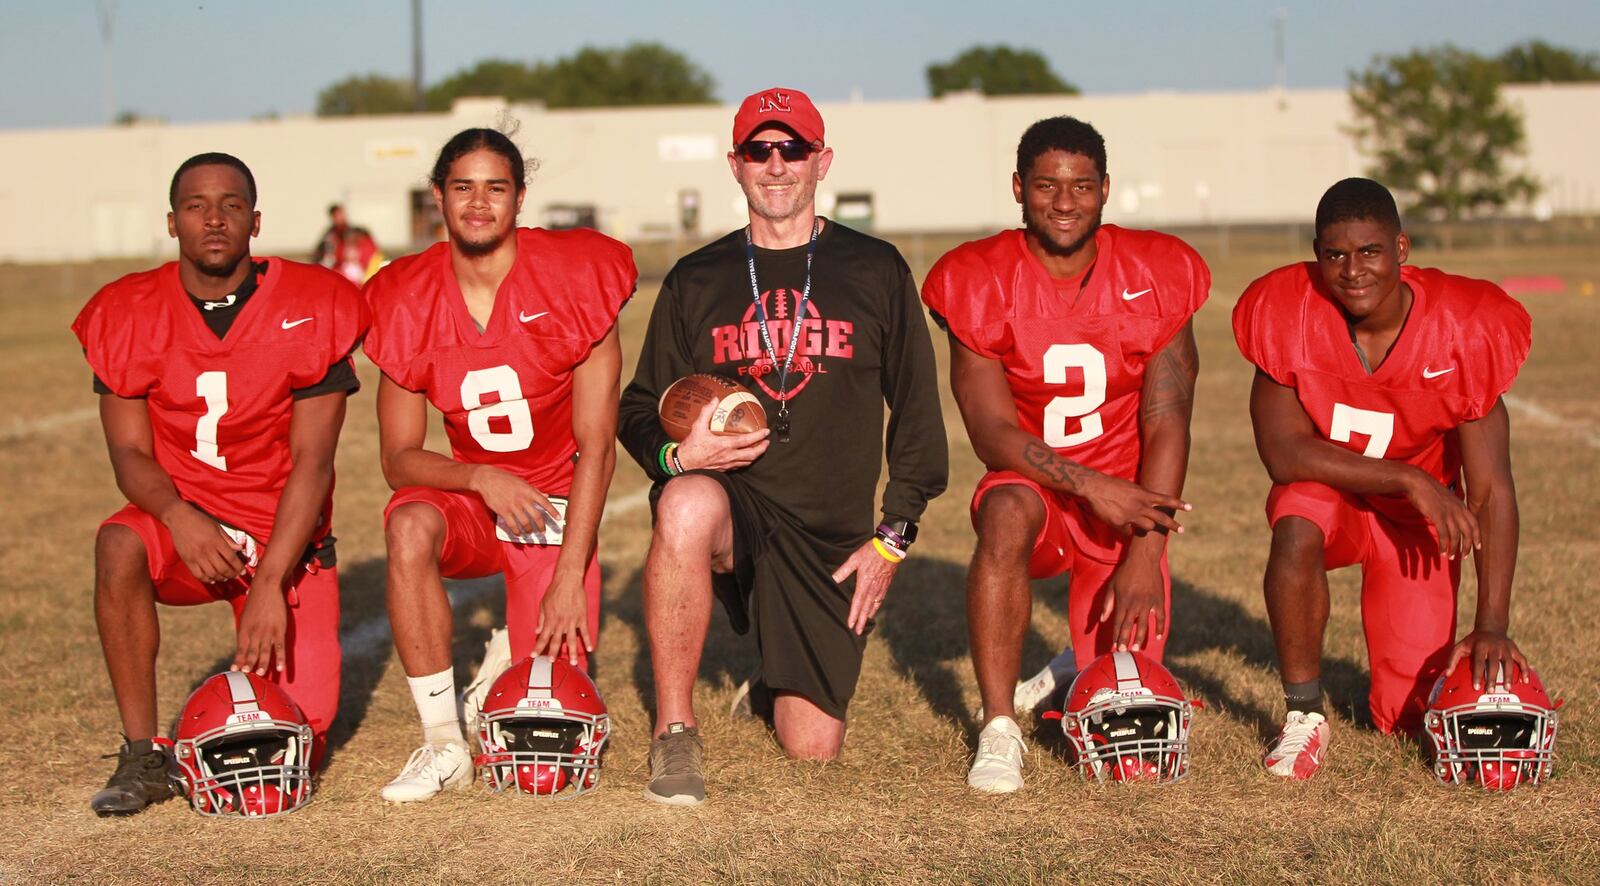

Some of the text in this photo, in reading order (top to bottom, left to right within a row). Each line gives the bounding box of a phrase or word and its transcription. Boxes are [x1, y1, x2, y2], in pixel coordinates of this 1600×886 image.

[759, 92, 791, 112] N
[711, 318, 854, 364] RIDGE
[737, 361, 828, 377] FOOBALL
[460, 364, 535, 453] 8
[1043, 343, 1107, 448] 2
[189, 371, 229, 472] 1
[1329, 402, 1395, 460] 7
[527, 700, 550, 709] TEAM
[1488, 696, 1511, 704] TEAM
[236, 713, 260, 724] TEAM
